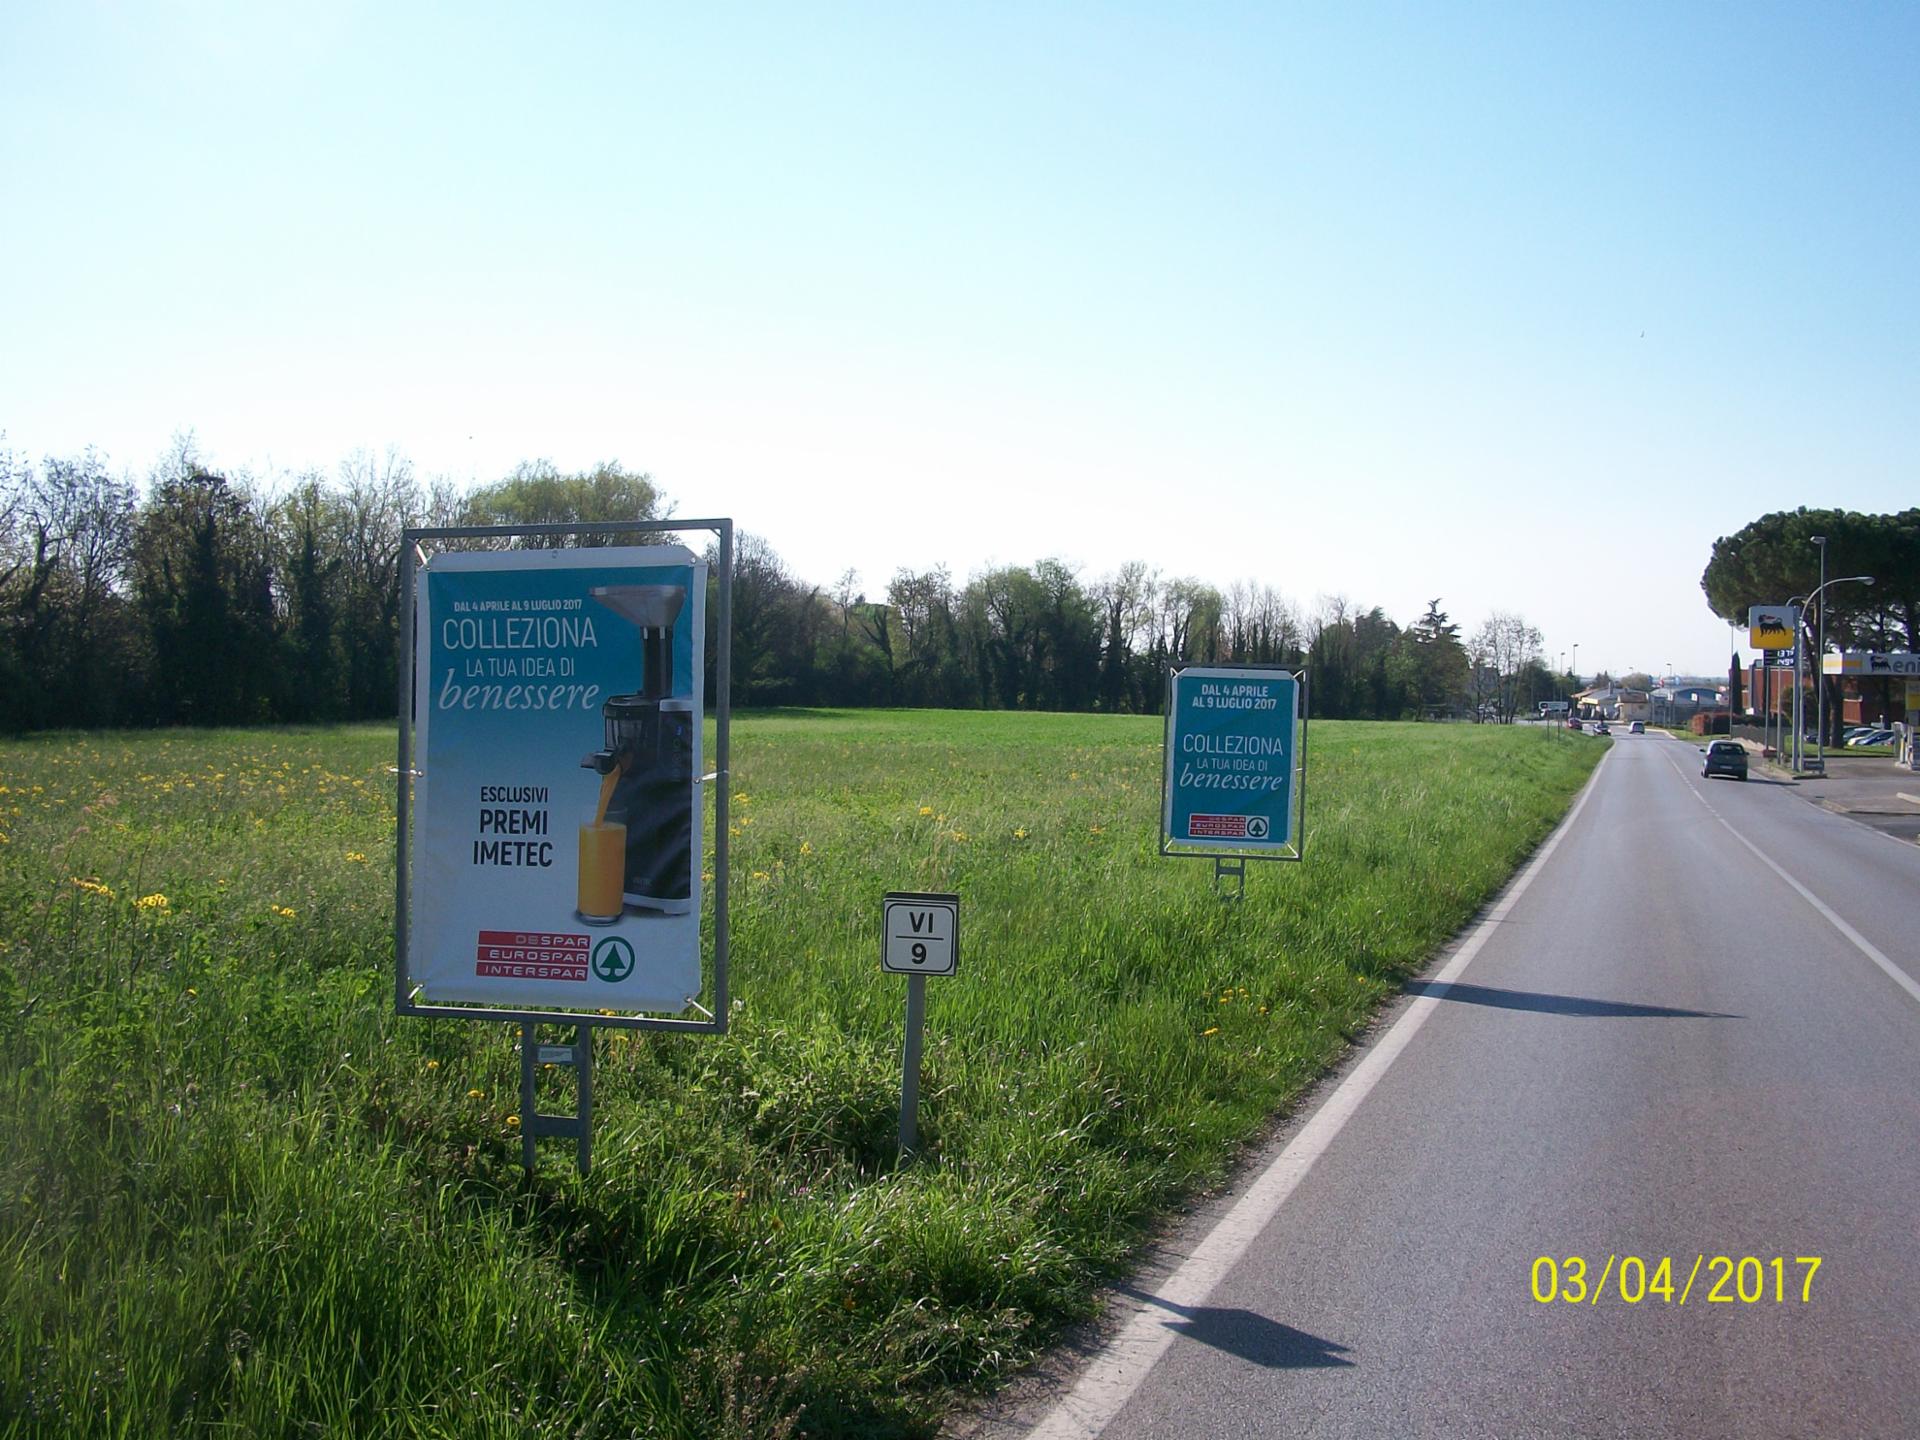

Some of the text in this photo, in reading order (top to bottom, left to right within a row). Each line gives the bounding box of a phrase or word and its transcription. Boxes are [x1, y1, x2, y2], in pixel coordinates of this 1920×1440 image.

[454, 599, 582, 612] DAL 4 APRILE AL 9 LUGLIO 2017
[443, 616, 598, 650] COLLEZIONA
[466, 657, 575, 677] LA TUA IDEA DI
[438, 668, 600, 710] benessere
[1201, 684, 1269, 697] DAL 4 APRILE
[1192, 697, 1277, 710] AL 9 LUGLIO 2017
[1183, 733, 1283, 756] COLLEZIONA
[1197, 758, 1268, 772] LA TUA IDEA DI
[1179, 762, 1283, 791] benessere
[480, 786, 549, 803] ESCLUSIVI
[479, 809, 548, 835] PREMI
[473, 840, 553, 867] IMETEC
[909, 911, 934, 933] VI
[515, 934, 589, 947] DESPAR
[489, 949, 588, 963] EUROSPAR
[911, 942, 927, 965] 9
[484, 965, 587, 979] INTERSPAR
